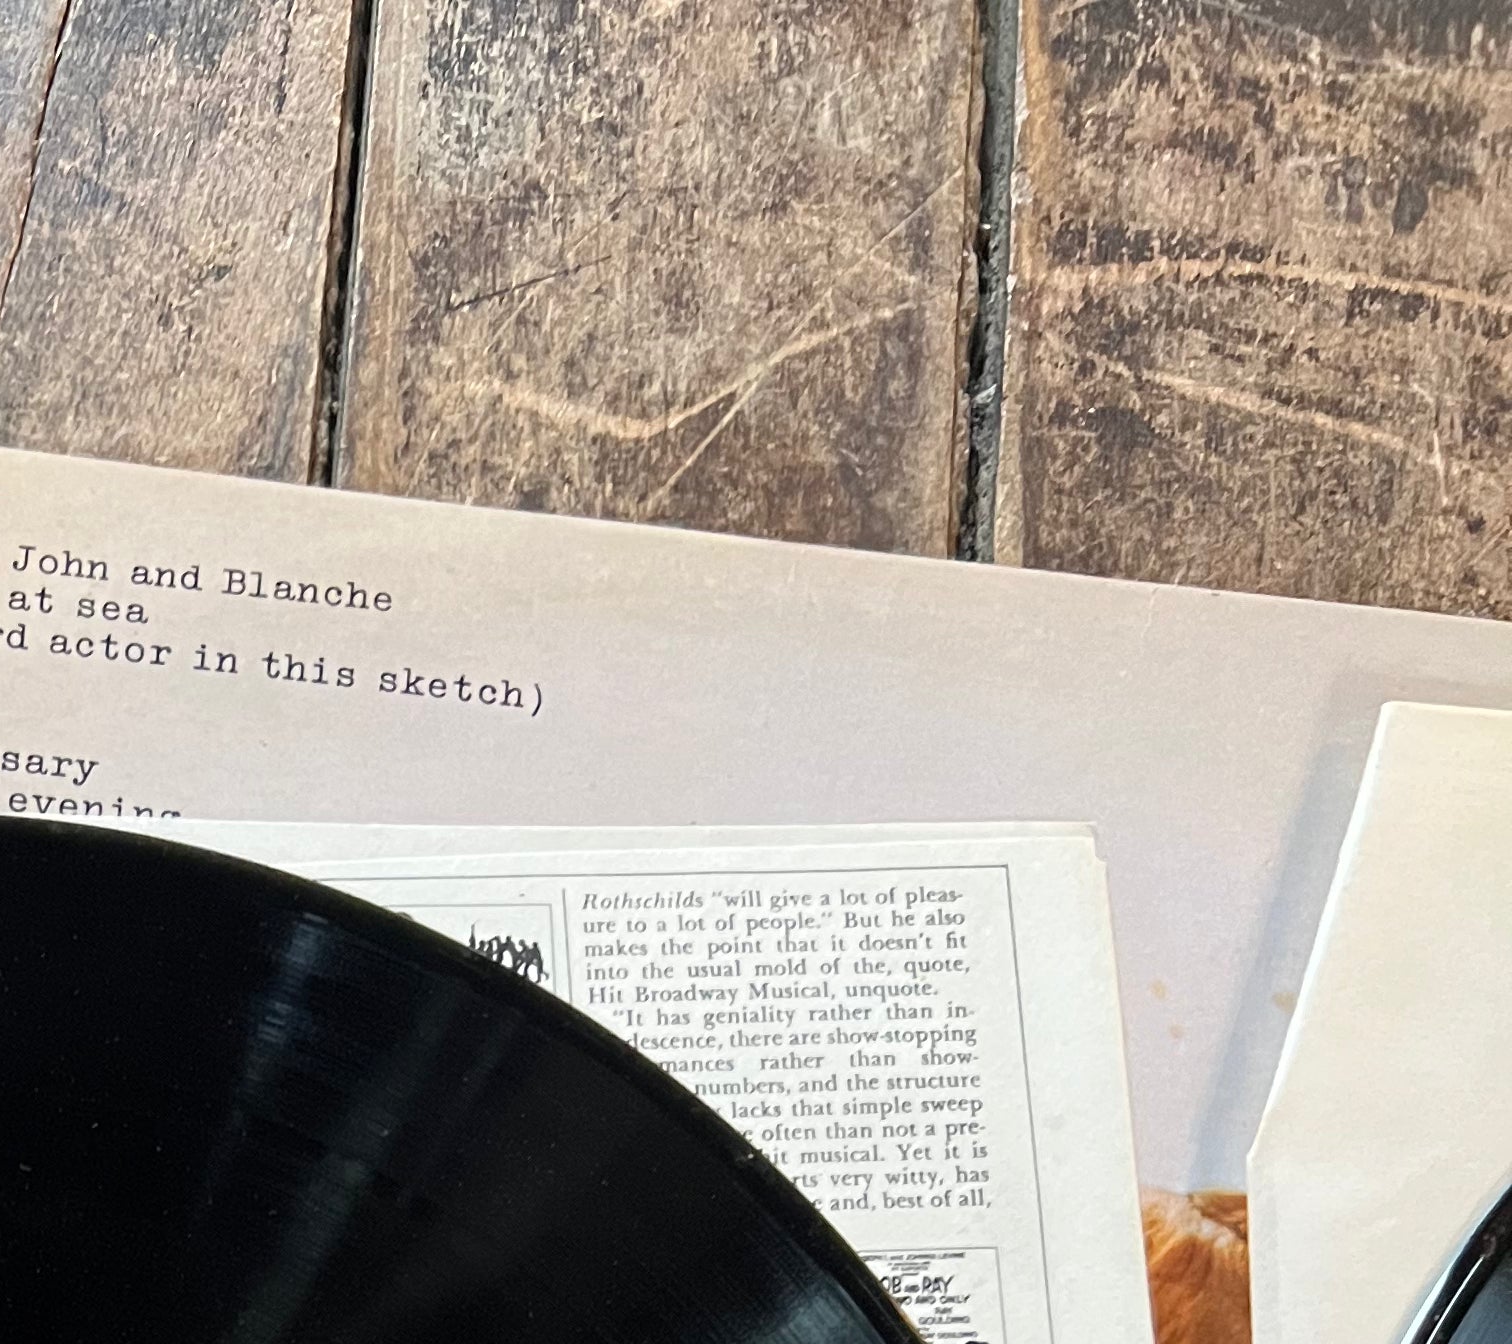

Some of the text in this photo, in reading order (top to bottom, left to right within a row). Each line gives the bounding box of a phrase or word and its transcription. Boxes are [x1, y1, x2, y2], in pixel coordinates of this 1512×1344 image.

[11, 544, 109, 582] John
[130, 564, 204, 592] and
[220, 567, 393, 613] Blanche
[7, 585, 54, 615] at
[76, 597, 150, 625] sea
[49, 633, 173, 666] actor
[192, 643, 239, 675] in
[260, 650, 355, 689] this
[378, 666, 544, 717] sketch)
[9, 785, 181, 817] evenin
[588, 980, 940, 1006] Hit Broadway Musical, unquote.
[694, 1073, 982, 1096] numbers, and the structure
[731, 1095, 984, 1121] lacks that simple sweep
